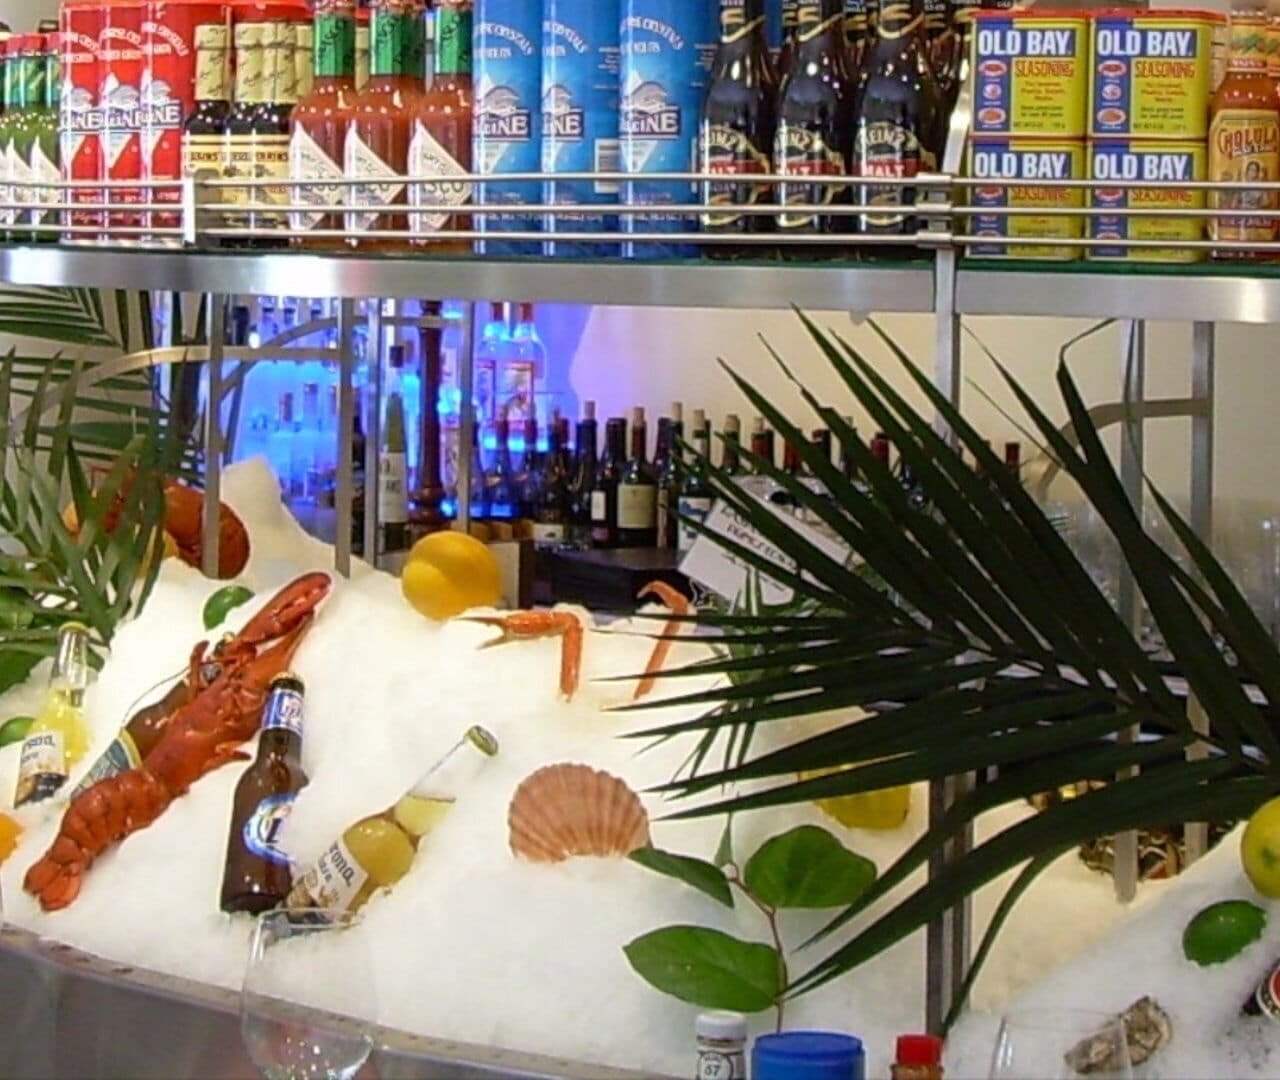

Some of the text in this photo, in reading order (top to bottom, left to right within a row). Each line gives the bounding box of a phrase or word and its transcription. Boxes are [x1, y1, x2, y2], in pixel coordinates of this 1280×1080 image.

[978, 29, 1070, 57] OLD BAY
[1097, 29, 1191, 58] OLD BAY
[1014, 60, 1075, 79] SEASONING
[1134, 60, 1196, 80] SEASONING
[1218, 127, 1278, 160] CHOLULA
[974, 152, 1066, 179] OLD BAY
[1094, 153, 1188, 180] OLD BAY
